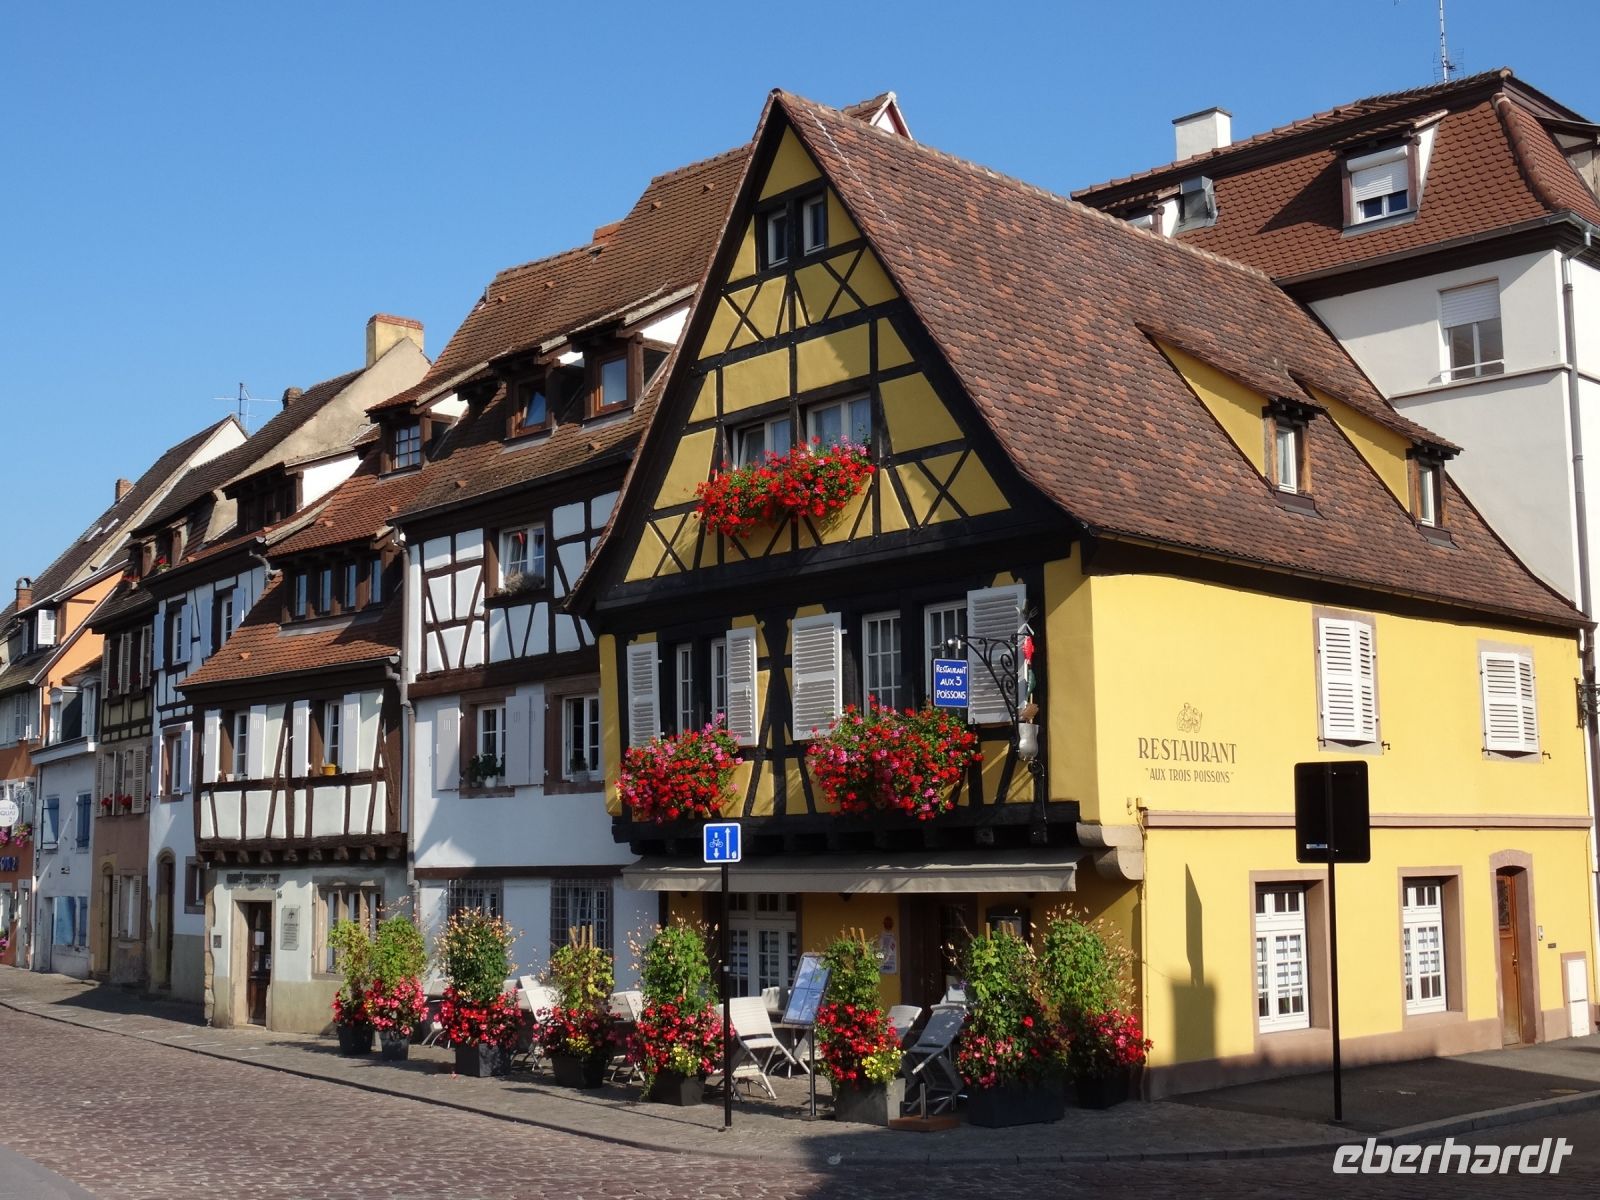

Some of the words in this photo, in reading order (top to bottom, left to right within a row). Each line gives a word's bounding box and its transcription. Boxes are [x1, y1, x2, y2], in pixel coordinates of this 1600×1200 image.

[936, 664, 967, 675] RESTAURANT
[940, 678, 954, 686] AUX
[955, 676, 962, 686] 3
[1138, 737, 1237, 764] RESTAURANT
[1168, 768, 1192, 782] TROIS
